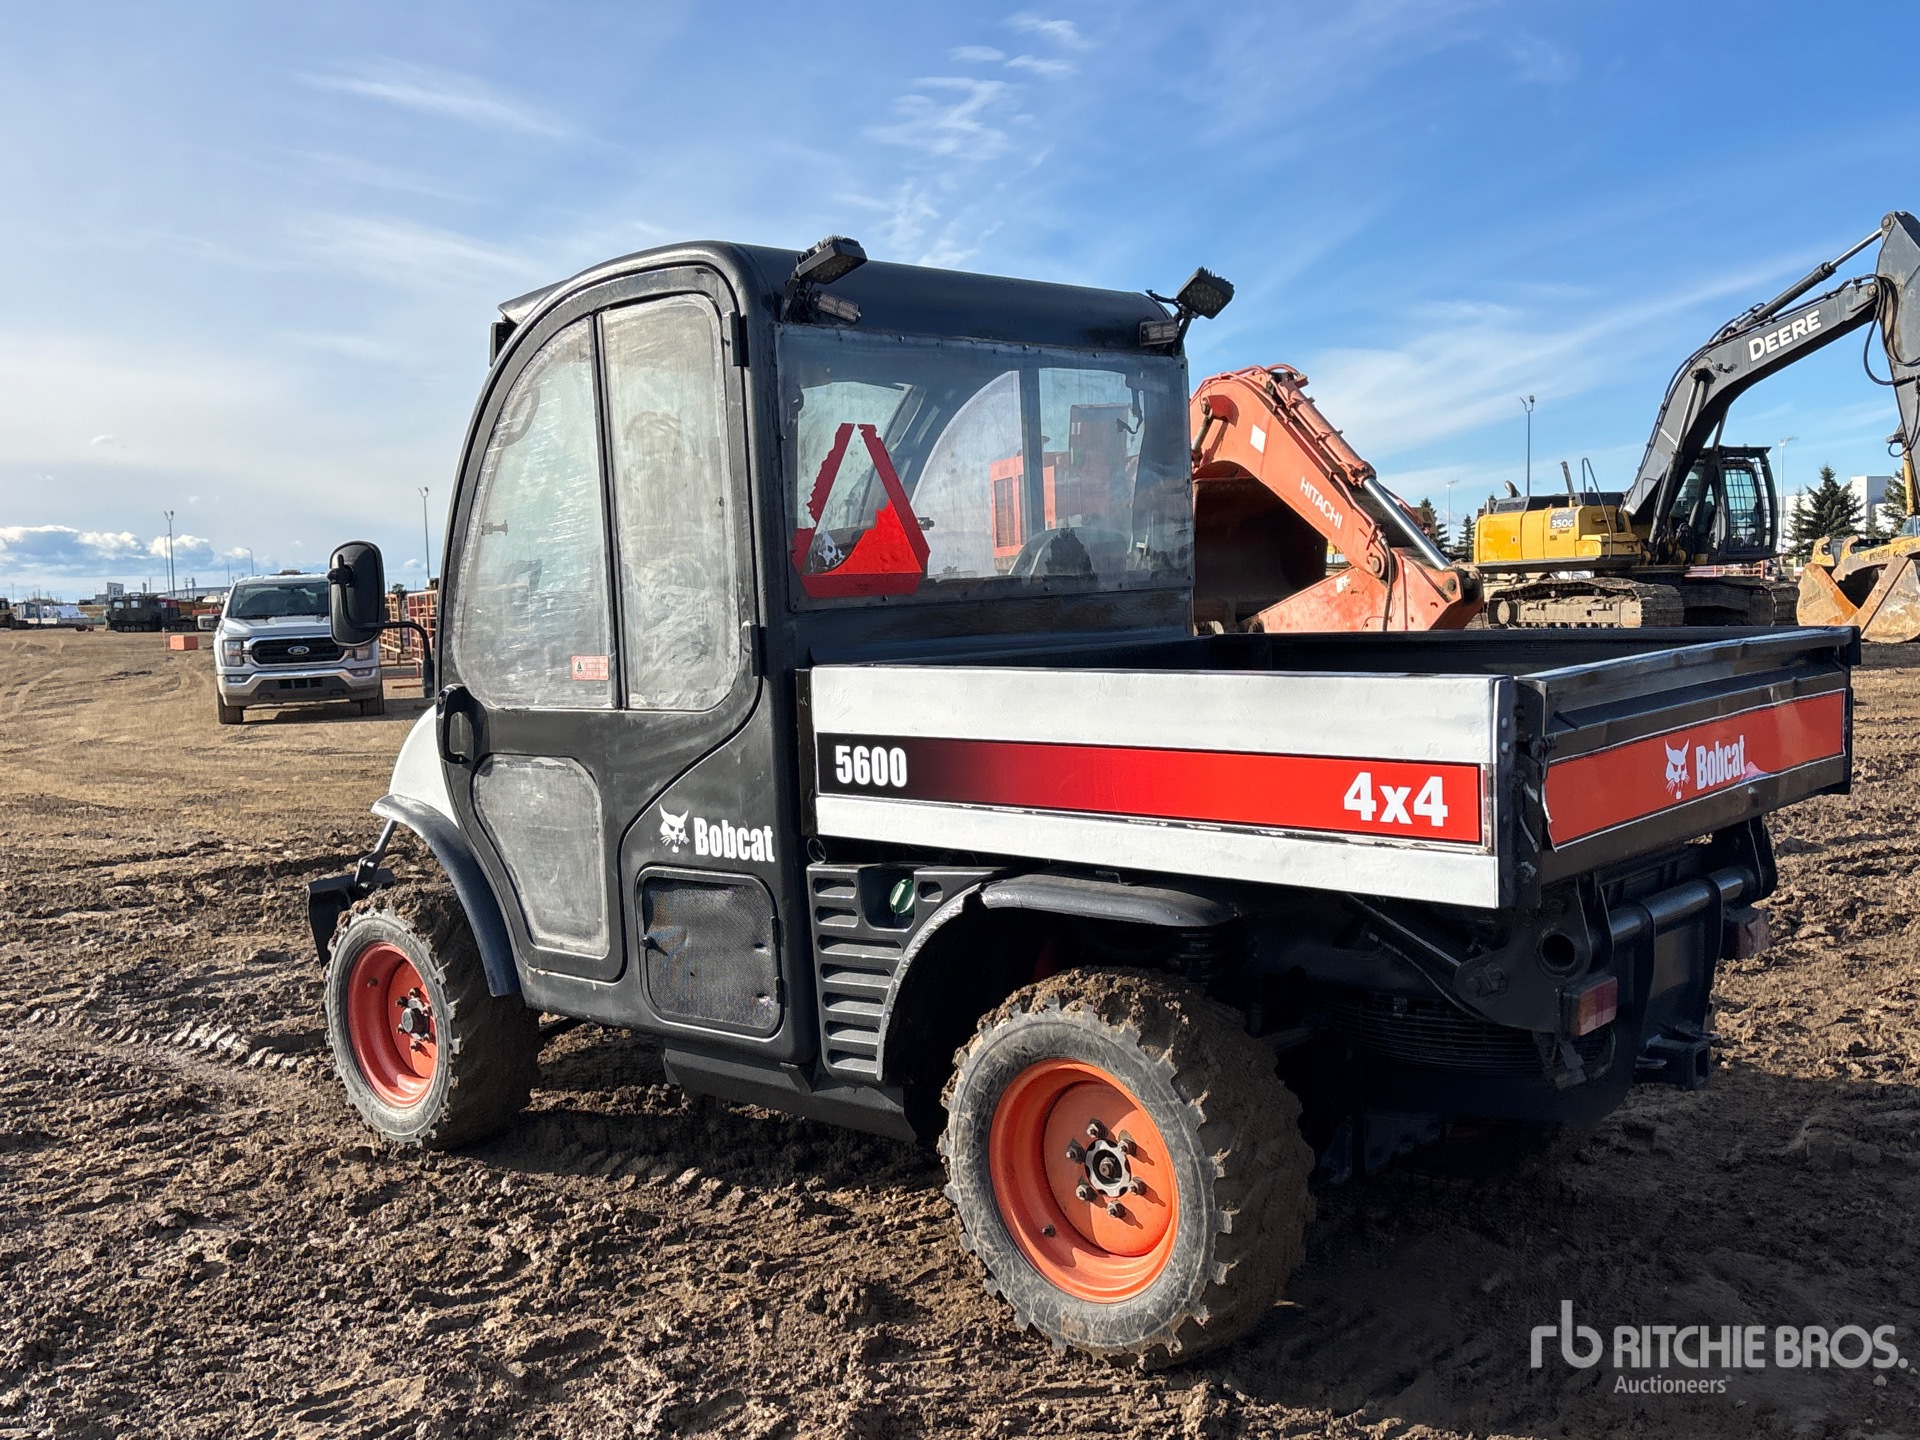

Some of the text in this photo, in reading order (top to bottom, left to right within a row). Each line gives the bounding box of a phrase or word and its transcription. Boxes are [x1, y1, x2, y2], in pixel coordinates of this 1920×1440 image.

[1748, 309, 1822, 362] DEERE
[1300, 476, 1343, 530] HITACHI
[1551, 518, 1574, 529] 350G
[835, 745, 908, 788] 5600
[1695, 734, 1746, 791] Bobcat
[1343, 771, 1449, 827] 4x4
[693, 816, 776, 863] Bobcat
